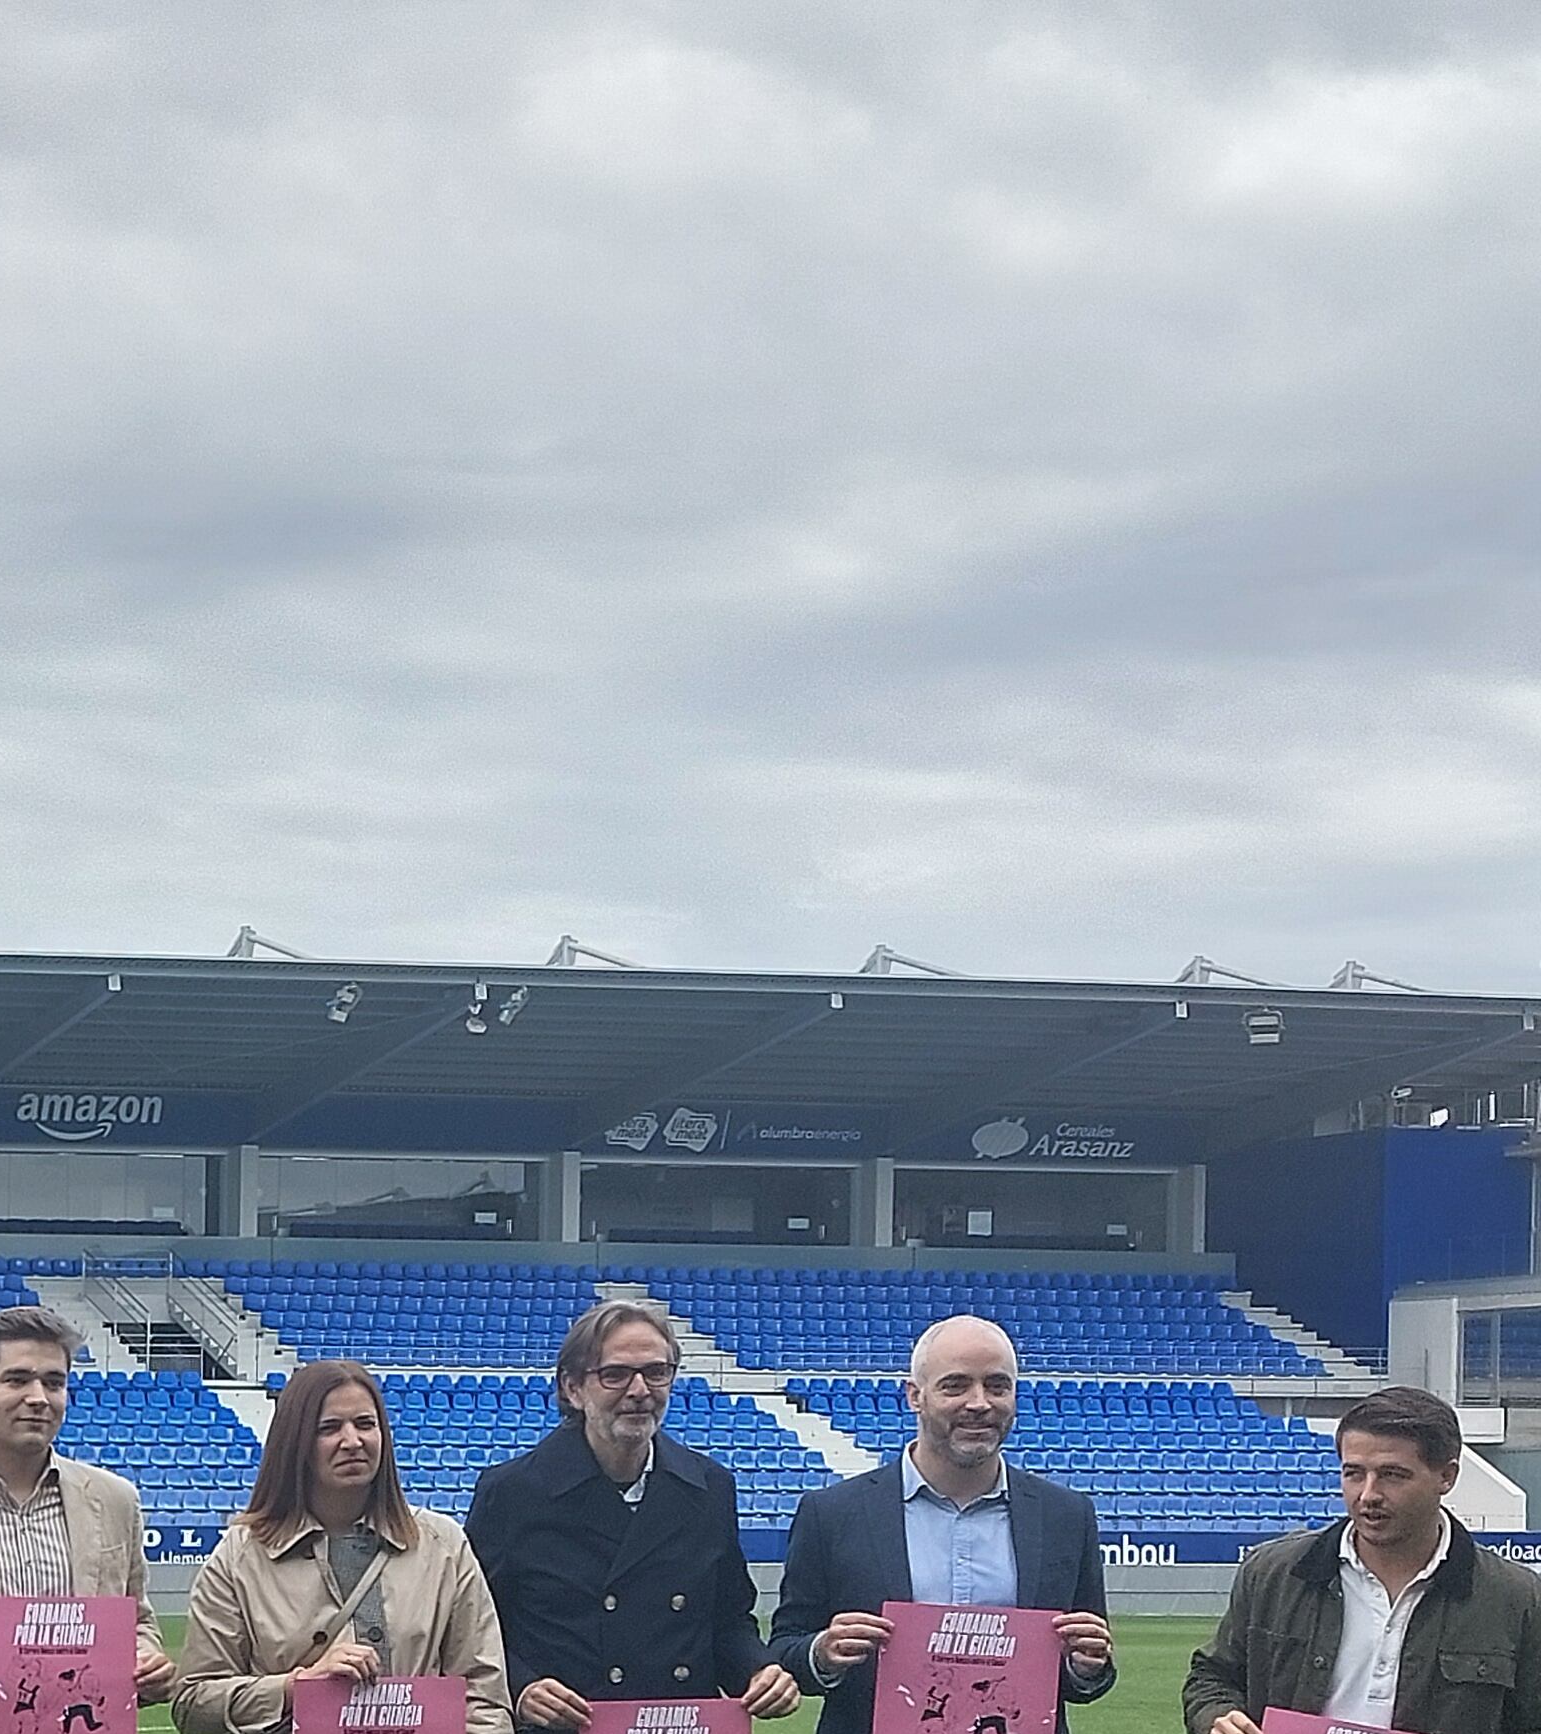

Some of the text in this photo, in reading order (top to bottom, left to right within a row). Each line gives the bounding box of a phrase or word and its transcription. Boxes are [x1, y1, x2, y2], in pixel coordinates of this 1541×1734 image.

[17, 1092, 162, 1124] amazon
[1056, 1123, 1115, 1138] Cereales
[1029, 1134, 1134, 1158] Arasanz
[25, 1603, 85, 1624] CORRAMOS
[941, 1612, 1007, 1635] CORRAMOS
[13, 1624, 96, 1646] POR LA CIENCIA
[927, 1632, 1016, 1658] POR LA CIENCIA
[339, 1705, 423, 1727] POR LA CIENCIA
[637, 1706, 699, 1727] CORRAMOS
